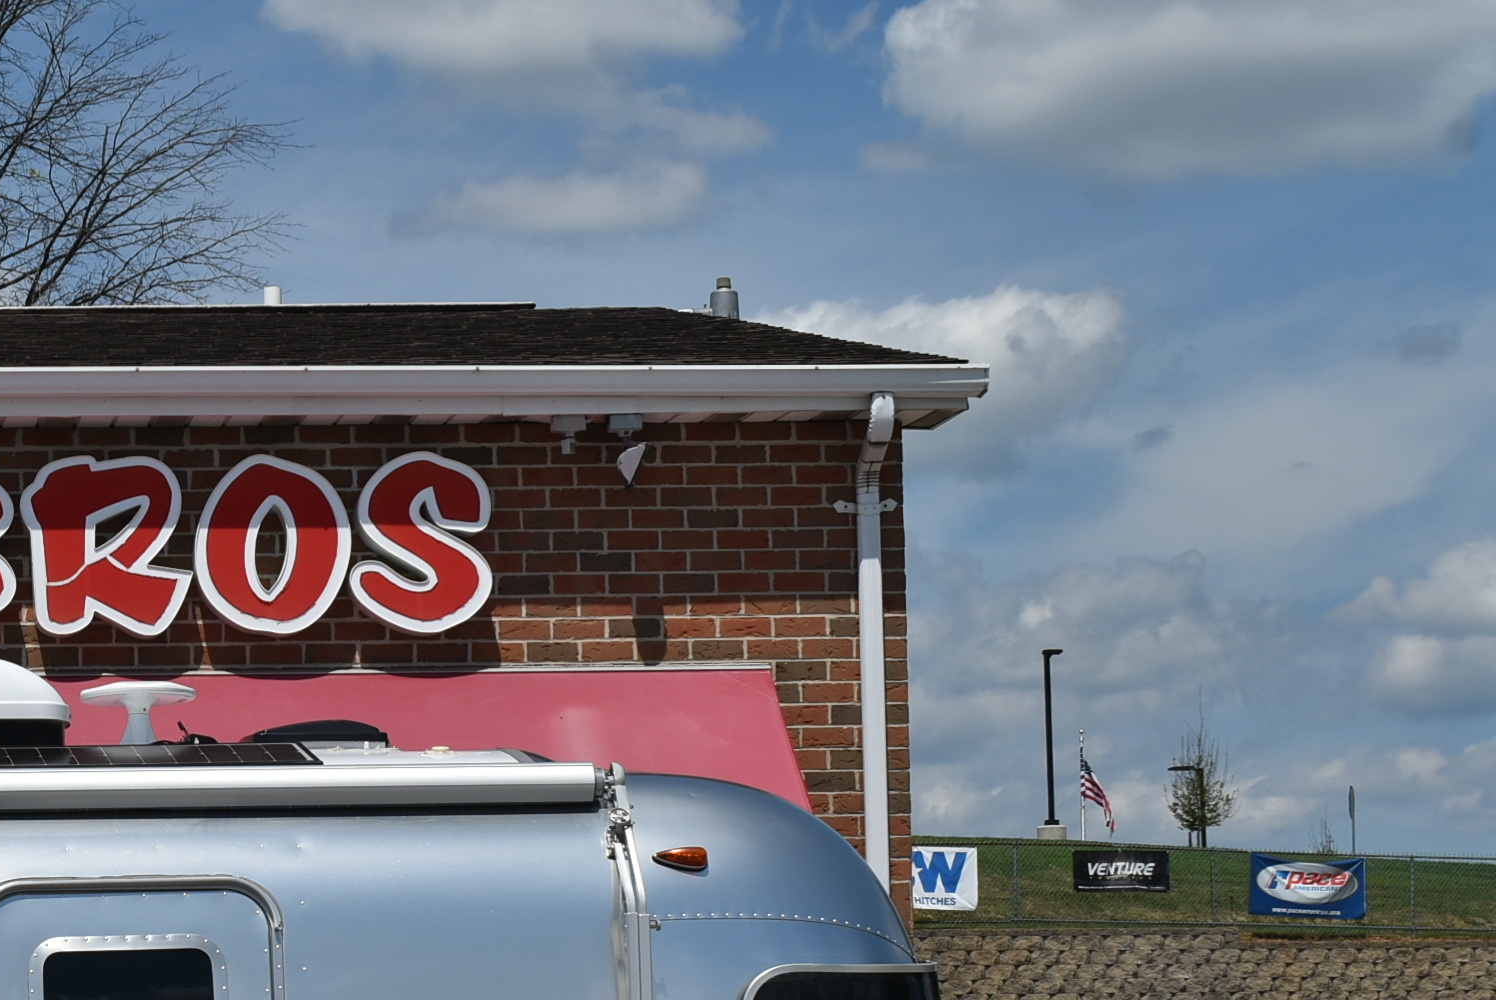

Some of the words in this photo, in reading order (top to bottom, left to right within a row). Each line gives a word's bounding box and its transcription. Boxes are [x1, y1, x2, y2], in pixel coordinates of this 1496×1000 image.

[1087, 862, 1156, 876] VENTURE
[1285, 871, 1349, 890] pace
[914, 896, 957, 906] HITCHES
